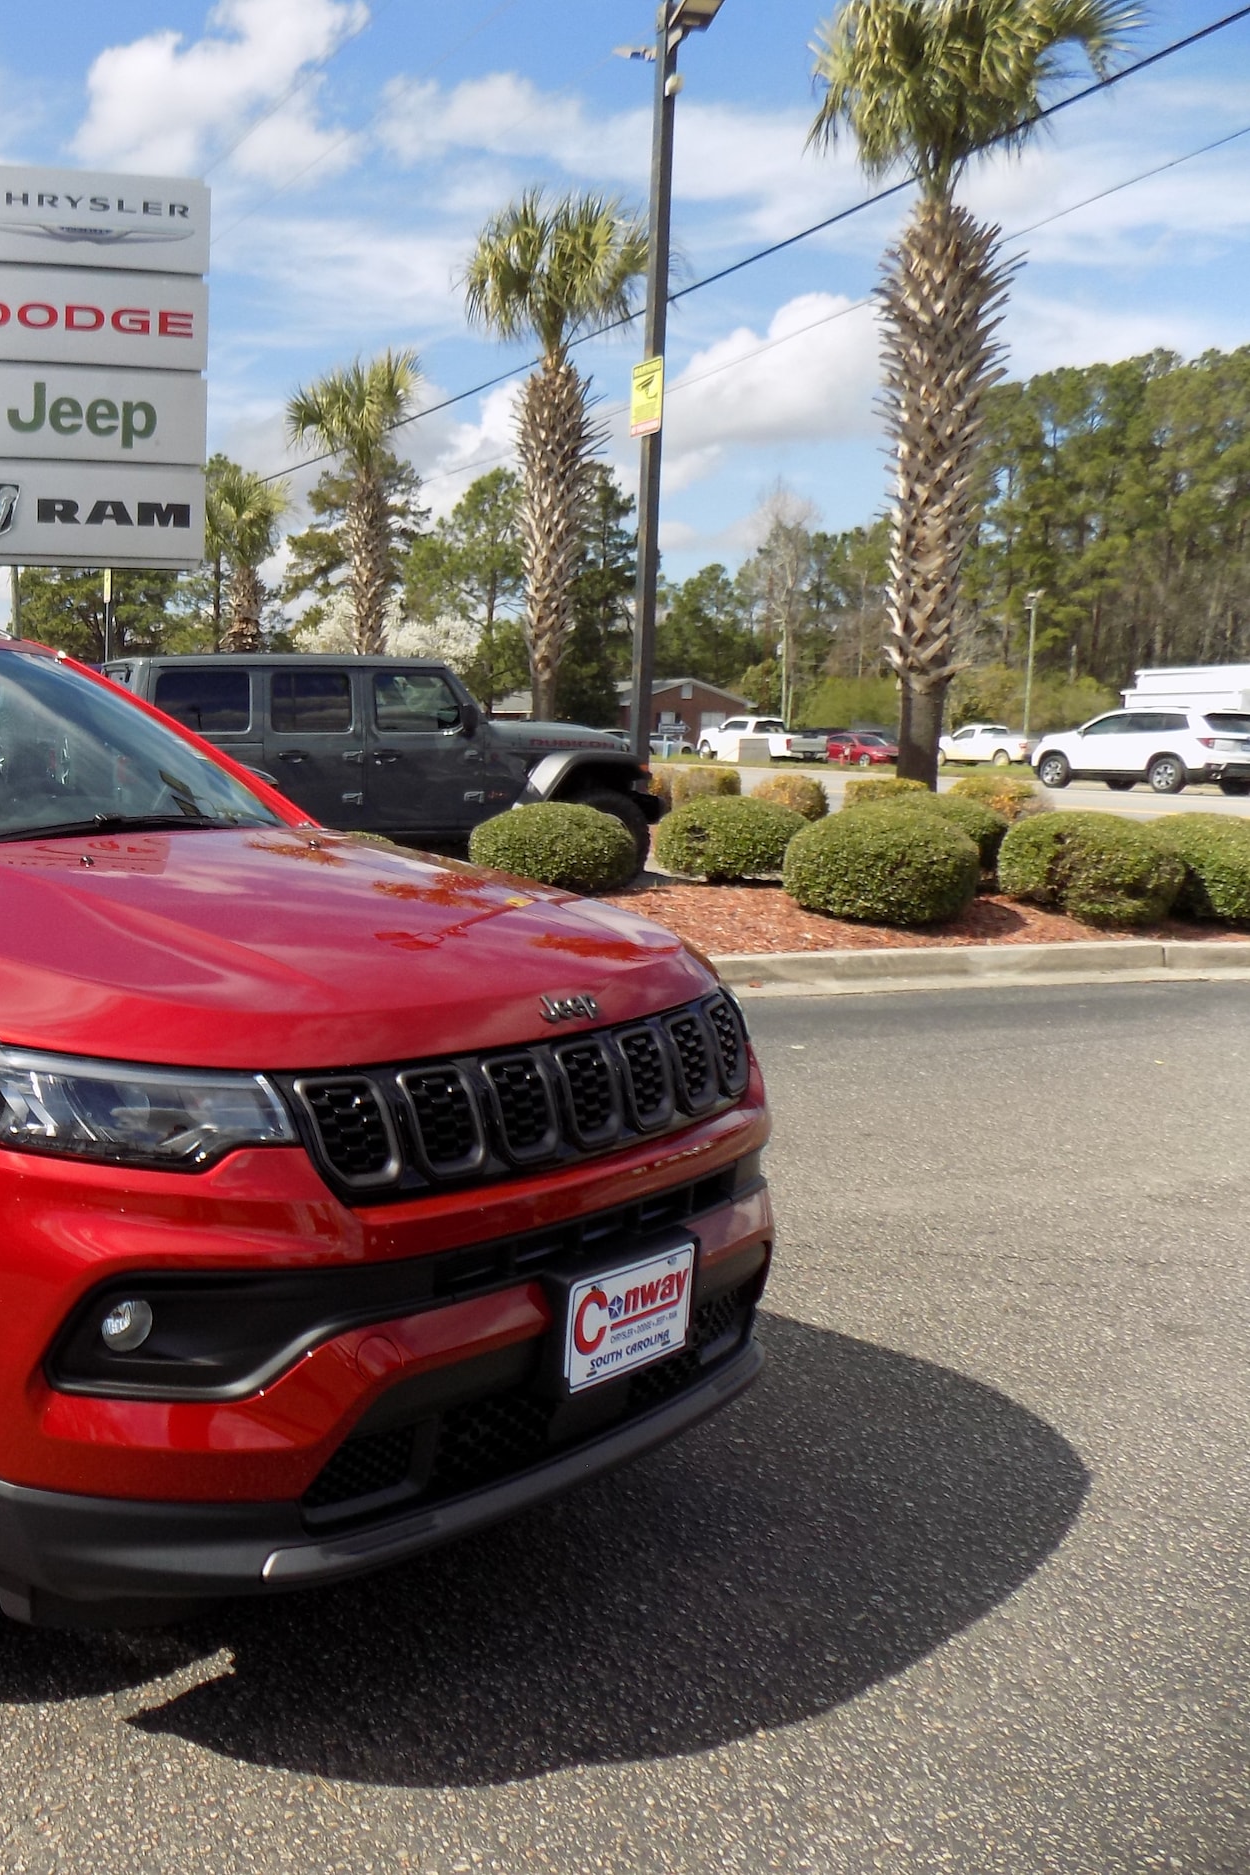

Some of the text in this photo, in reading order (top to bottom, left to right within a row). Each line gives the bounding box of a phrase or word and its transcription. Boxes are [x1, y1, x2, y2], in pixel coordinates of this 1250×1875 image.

[6, 381, 158, 449] Jeep
[36, 498, 191, 529] RAM
[529, 738, 615, 749] RUBICON
[539, 994, 600, 1024] Jeep
[589, 1329, 670, 1370] SOUTH CAROLINA
